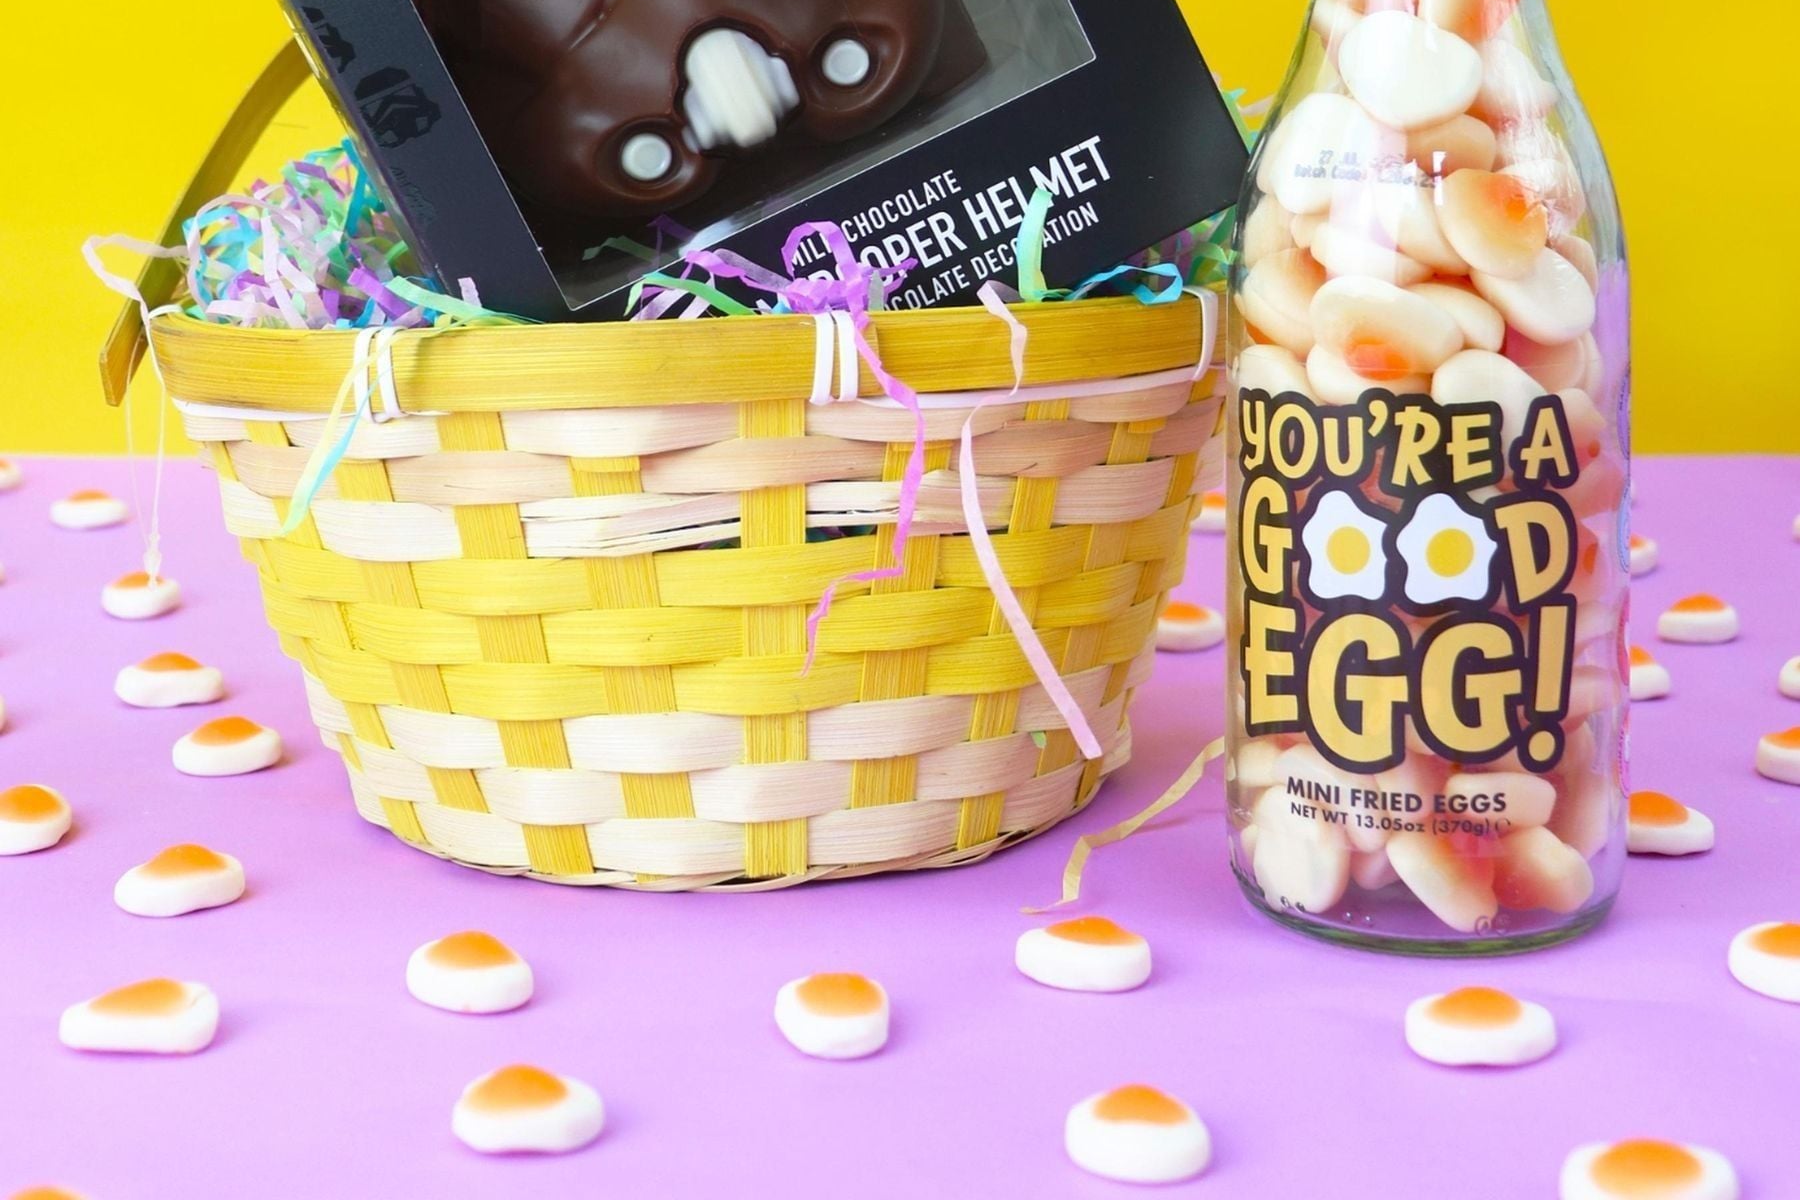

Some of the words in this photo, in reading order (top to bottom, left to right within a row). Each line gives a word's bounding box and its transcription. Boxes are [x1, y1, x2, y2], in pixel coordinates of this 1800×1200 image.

[840, 169, 962, 243] CHOCOLATE
[962, 135, 1111, 241] HELMET
[970, 202, 1100, 280] DECATION
[1519, 406, 1571, 481] A
[1244, 601, 1569, 763] EGG!
[1286, 776, 1341, 805] MINI
[1350, 787, 1423, 812] FRIED
[1433, 792, 1507, 814] EGGS
[1290, 802, 1317, 820] NET
[1322, 809, 1348, 825] WT
[1355, 814, 1425, 832] 13.05oz
[1432, 818, 1490, 837] (370g)
